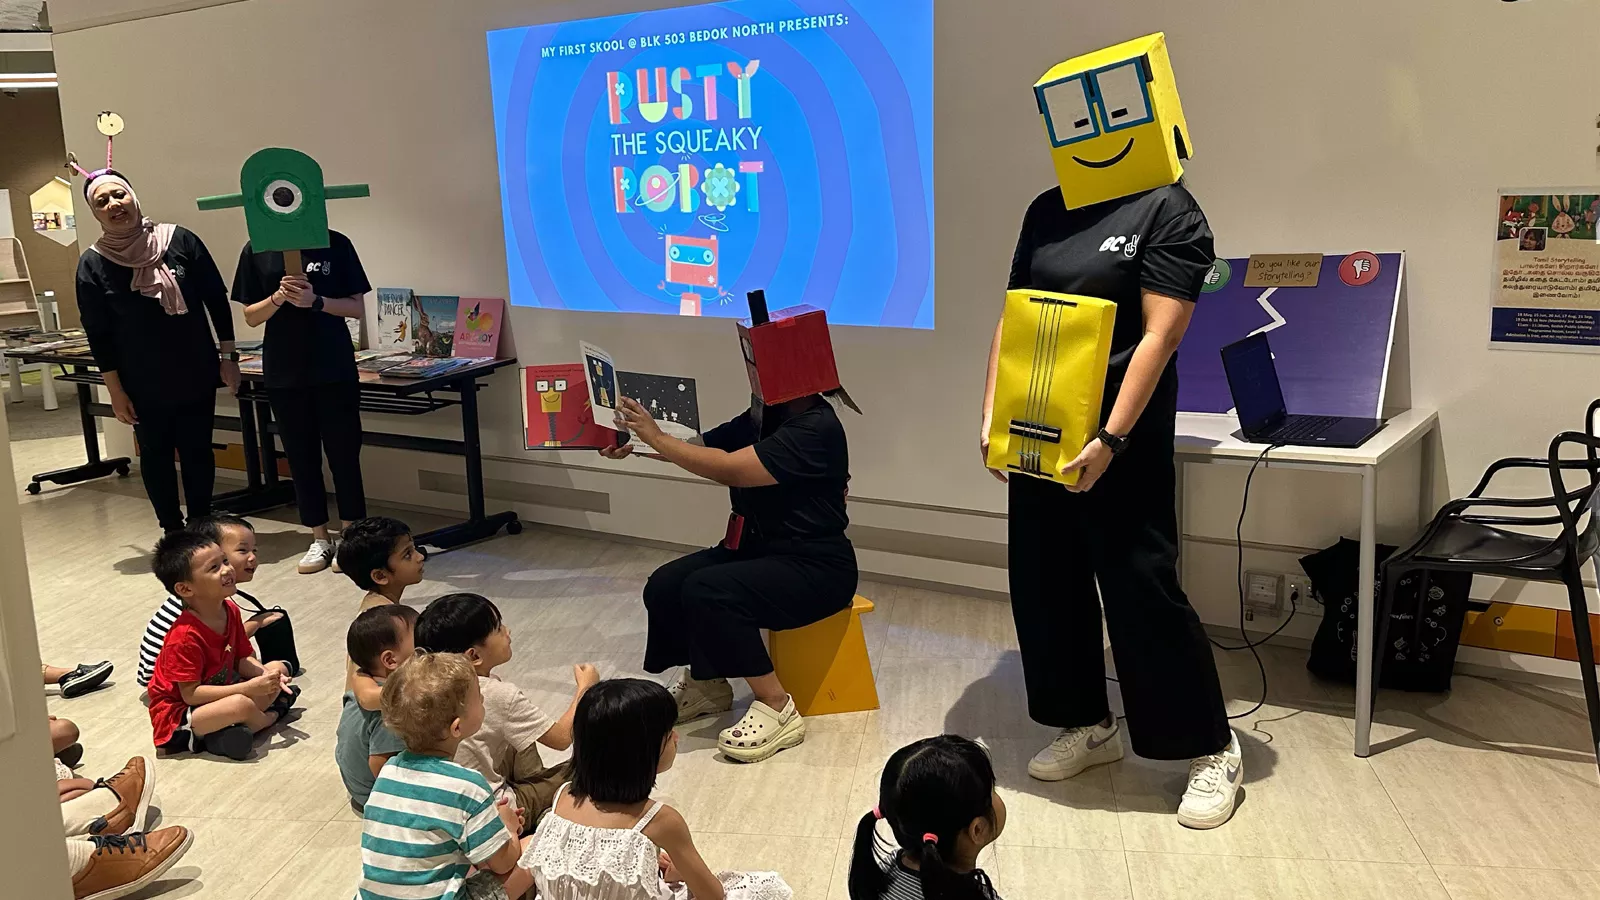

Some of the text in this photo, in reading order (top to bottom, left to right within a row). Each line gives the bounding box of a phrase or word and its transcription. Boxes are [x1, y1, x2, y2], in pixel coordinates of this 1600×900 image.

[541, 13, 849, 58] MY FIRST SKOOL @ BLK 503 BEDOK NORTH PRESENTS:
[607, 59, 760, 125] RUSTY
[611, 126, 763, 155] THE SQUEAKY
[613, 161, 764, 213] ROBOT
[305, 261, 322, 273] BC
[1253, 260, 1265, 269] Do
[1267, 261, 1282, 273] you
[1287, 259, 1300, 267] like
